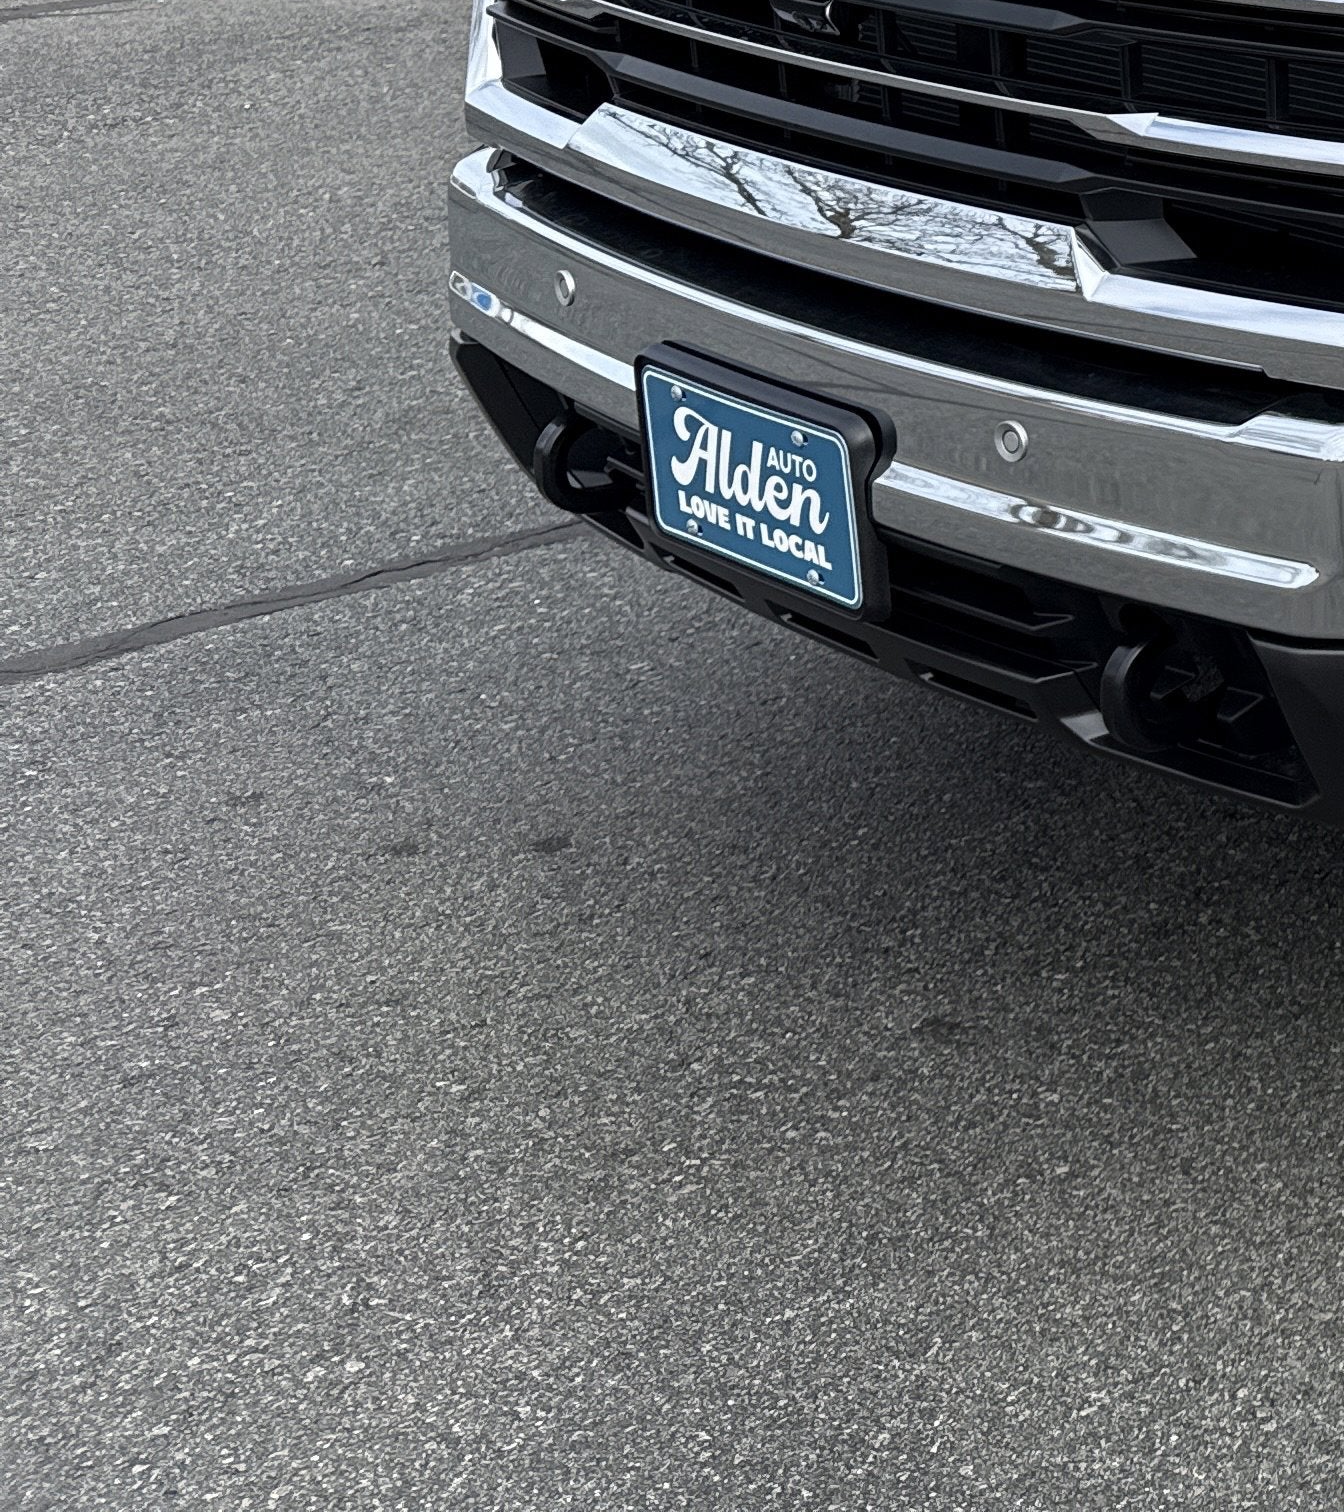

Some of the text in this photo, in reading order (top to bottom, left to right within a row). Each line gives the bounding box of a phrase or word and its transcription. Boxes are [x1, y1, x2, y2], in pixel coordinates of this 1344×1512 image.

[670, 406, 829, 535] Alden
[766, 446, 817, 482] AUTO
[677, 489, 833, 571] LOVE IT LOCAL
